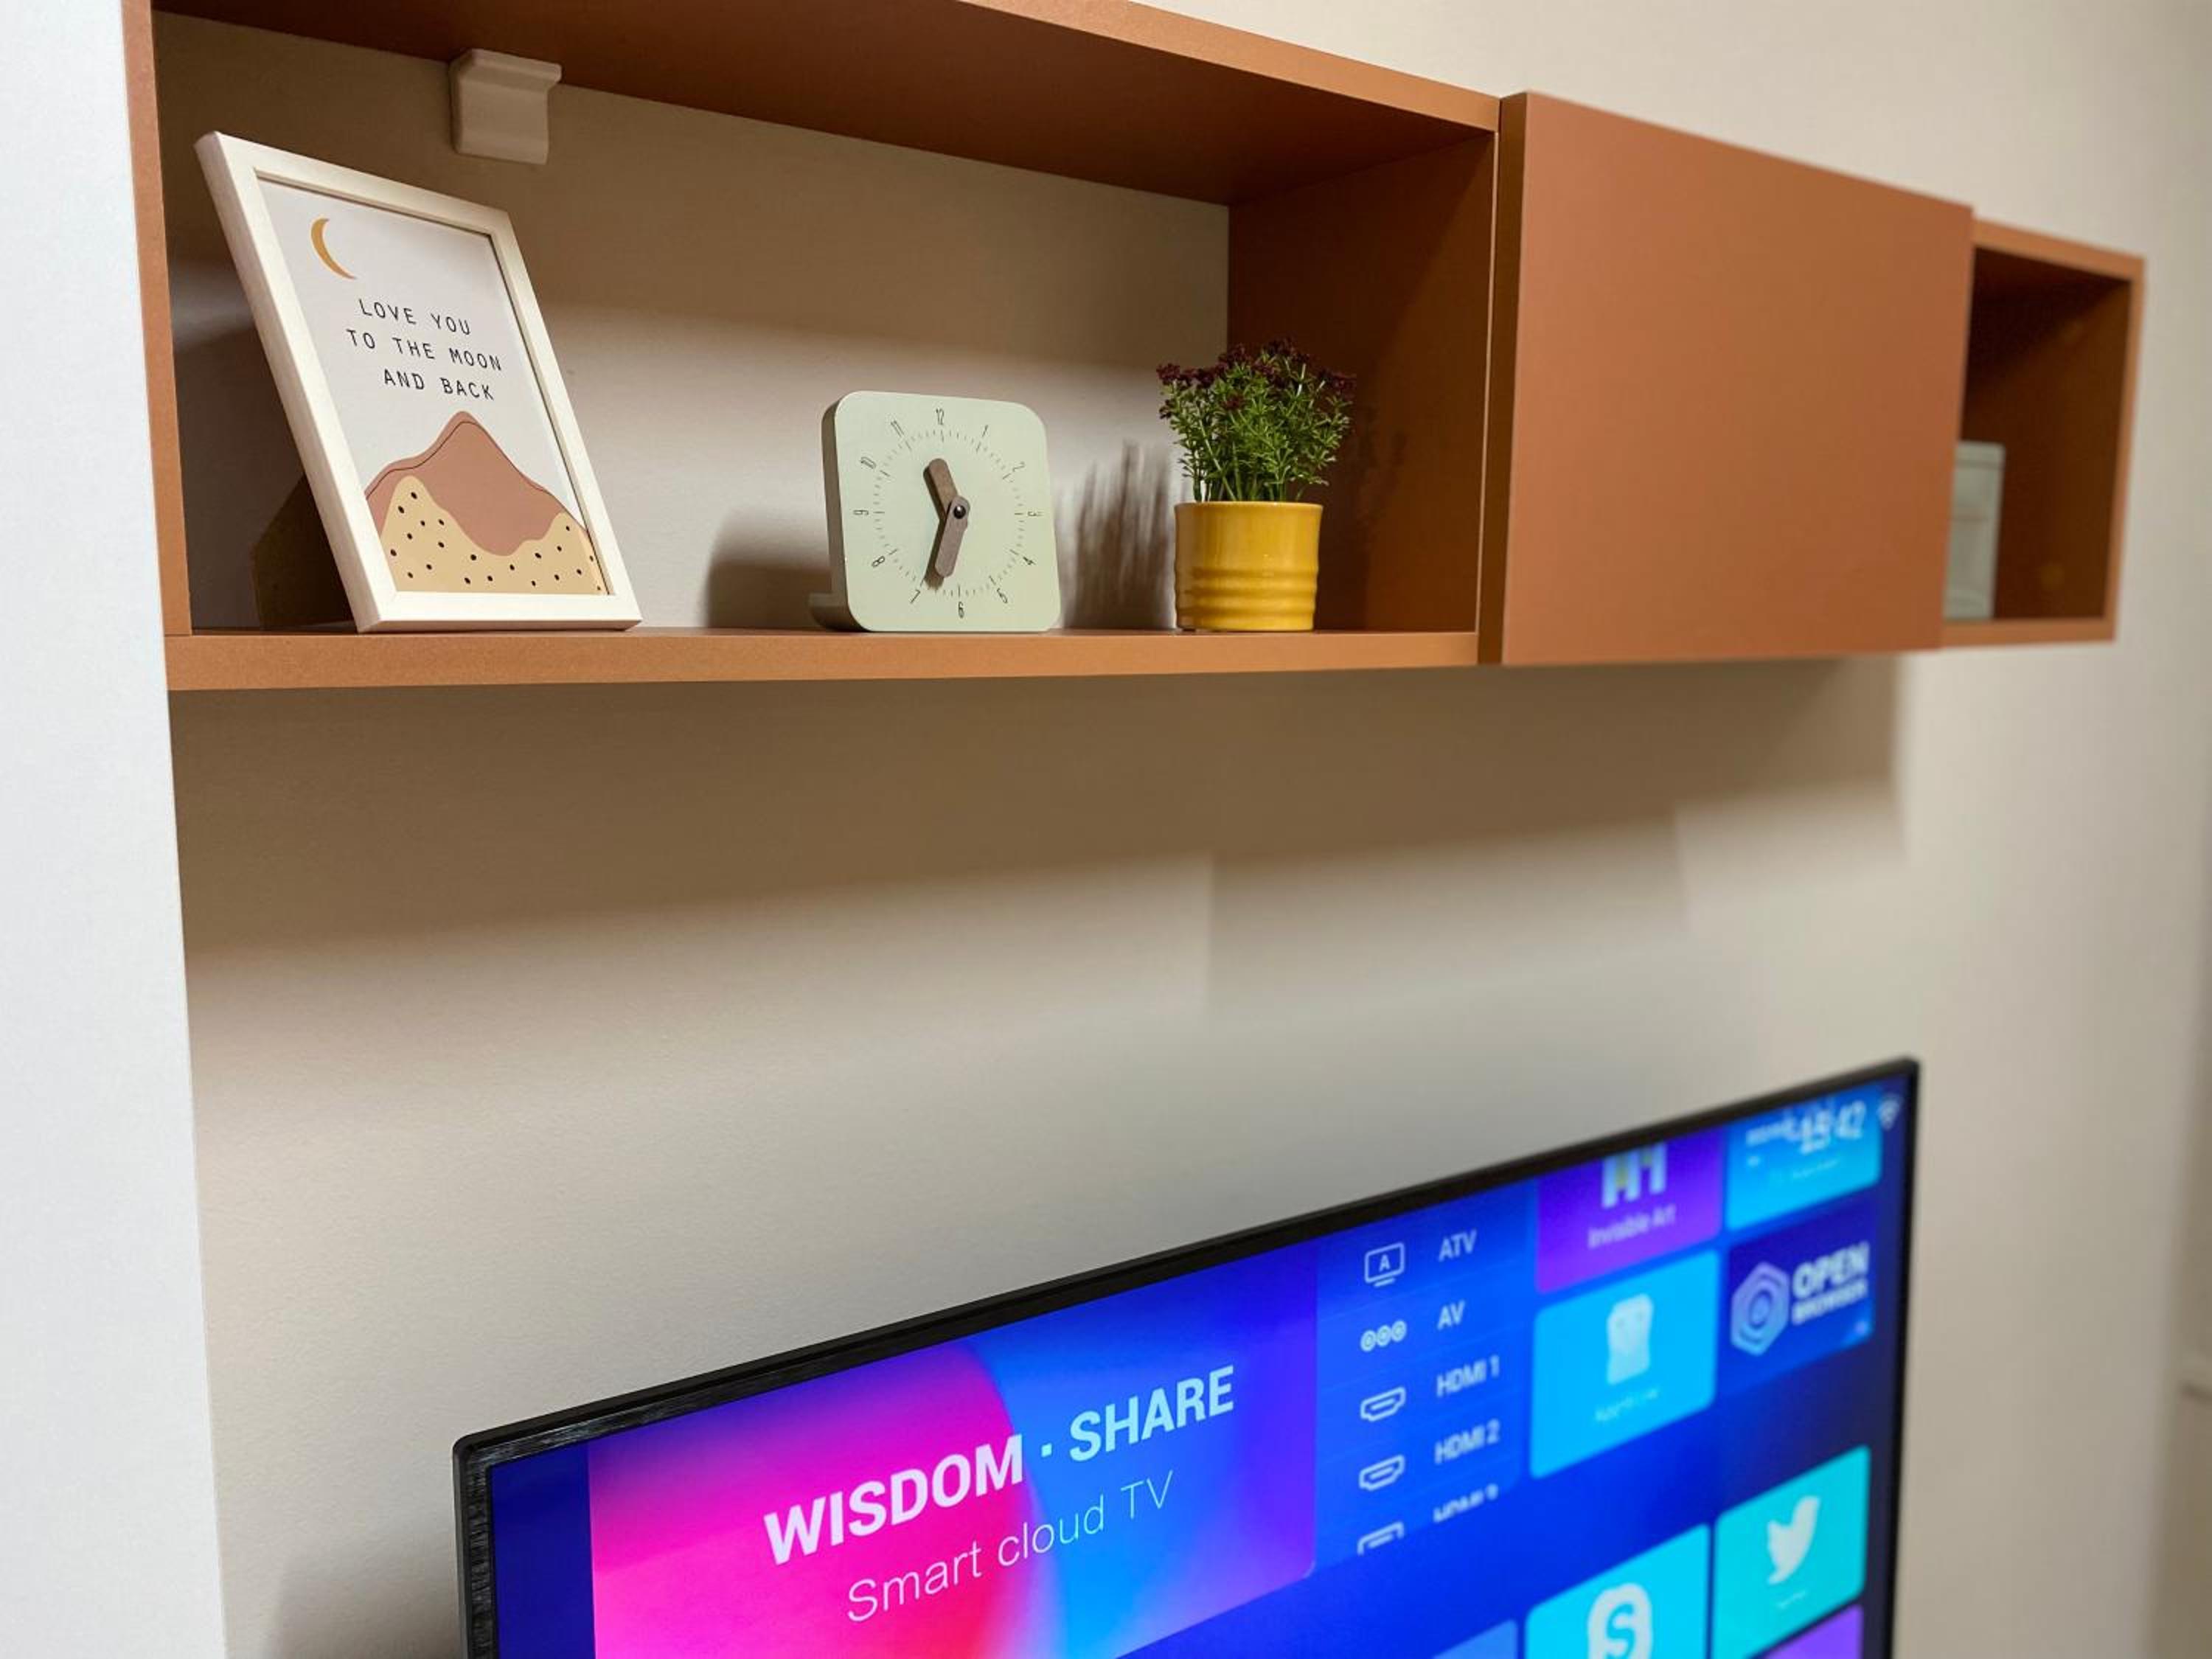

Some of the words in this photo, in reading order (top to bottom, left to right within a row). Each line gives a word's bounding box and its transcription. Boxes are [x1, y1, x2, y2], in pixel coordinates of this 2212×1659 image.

[358, 299, 417, 325] LOVE
[430, 313, 471, 336] YOU
[346, 329, 376, 350] TO
[392, 338, 435, 361] THE
[449, 349, 502, 372] MOON
[383, 369, 425, 391] AND
[441, 378, 495, 400] BACK
[891, 420, 905, 437] 11
[936, 408, 945, 425] 12
[981, 425, 989, 438] 1
[860, 456, 877, 470] 10
[1013, 462, 1026, 472] 2
[872, 556, 886, 568] 8
[1023, 556, 1035, 566] 4
[909, 588, 921, 604] 7
[997, 588, 1009, 603] 5
[958, 602, 965, 619] 6
[1439, 1228, 1478, 1262] ATV
[1792, 1241, 1869, 1299] OPEN
[1437, 1299, 1466, 1330] AV
[1436, 1359, 1487, 1397] HDMI
[1489, 1354, 1500, 1377] 1
[1434, 1425, 1486, 1464] HDMI
[1486, 1419, 1501, 1444] 2
[762, 1433, 1025, 1567] WISDOM
[1068, 1364, 1236, 1464] SHARE
[846, 1541, 985, 1623] Smart
[997, 1495, 1107, 1568] cloud
[1119, 1470, 1175, 1523] TV
